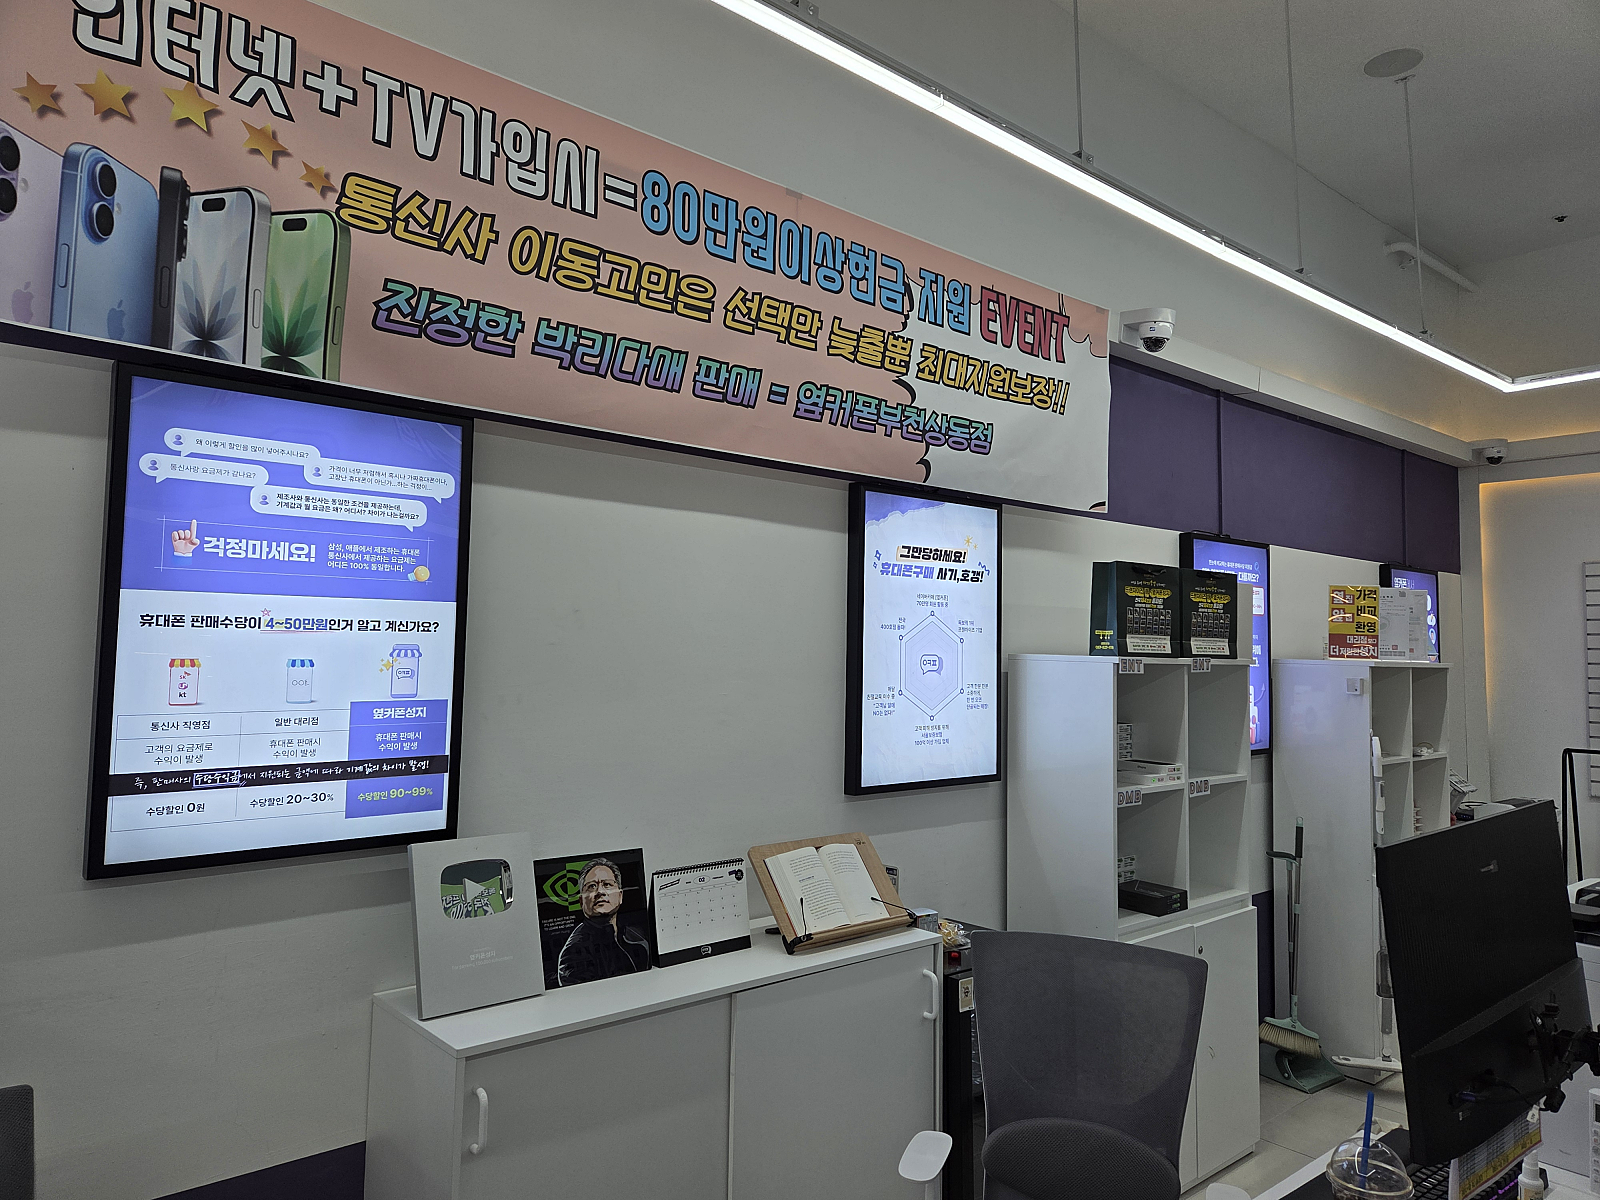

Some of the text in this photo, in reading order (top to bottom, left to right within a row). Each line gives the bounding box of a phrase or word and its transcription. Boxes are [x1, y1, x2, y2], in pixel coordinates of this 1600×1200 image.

[336, 172, 1070, 416] 통신사 이동고민은 선택만 늦출뿐 최대지원보장!!
[917, 268, 972, 336] 지원
[980, 287, 1070, 364] EVENT
[372, 277, 524, 358] 진정한
[531, 317, 687, 395] 박리다매
[693, 355, 762, 408] 판매
[793, 381, 994, 455] 옆커폰부천상동점
[195, 438, 203, 446] 왜
[205, 440, 226, 449] 이렇게
[228, 442, 248, 451] 할인을
[170, 463, 199, 473] 통신사랑
[201, 466, 230, 477] 요금제가
[328, 466, 348, 474] 가격이
[348, 476, 373, 485] 휴대폰이
[276, 493, 303, 502] 제조사와
[305, 495, 330, 505] 통신사는
[331, 498, 350, 507] 동일한
[351, 500, 369, 508] 조건을
[276, 501, 303, 511] 기계값과
[312, 504, 331, 513] 요금은
[332, 506, 343, 514] 왜?
[344, 507, 366, 516] 어디서?
[368, 509, 386, 518] 차이가
[203, 536, 316, 563] 걱정마세요!
[328, 543, 344, 552] 삼성,
[374, 547, 401, 555] 제조하는
[402, 548, 420, 557] 휴대폰
[900, 545, 967, 564] 그만당하세요!
[328, 552, 416, 565] 통신사에서 제공하는 요금제는
[328, 561, 405, 573] 어디든 100% 동일합니다.
[880, 562, 935, 579] 휴대폰구매
[1356, 589, 1377, 601] 가격
[1356, 605, 1377, 616] 비교
[139, 613, 440, 633] 휴대폰 판매수당이 4~50만원인거 알고 계신가요?
[1355, 621, 1376, 633] 환영
[1346, 636, 1367, 644] 대리점
[1330, 645, 1339, 655] 더
[1121, 659, 1143, 672] ENT
[1192, 658, 1211, 671] ENT
[373, 706, 428, 720] 옆커폰성지
[150, 720, 211, 732] 통신사 직영점
[274, 716, 319, 727] 일반 대리점
[269, 737, 322, 749] 휴대폰 판매시
[375, 731, 422, 742] 휴대폰 판매시
[144, 743, 214, 754] 고객의 요금제로
[378, 741, 418, 752] 수익이 발생
[154, 754, 204, 766] 수익이 발생
[272, 748, 317, 759] 수익이 발생
[151, 776, 191, 787] 판매사의
[260, 770, 291, 780] 지원되는
[294, 766, 319, 779] 금액에
[321, 766, 343, 775] 따라
[346, 763, 380, 775] 기계값의
[382, 761, 407, 771] 차이가
[408, 759, 430, 772] 발생!
[250, 792, 334, 808] 수당할인 20~30%
[357, 786, 433, 802] 수당할인 90~99%
[146, 802, 205, 817] 수당할인 0원
